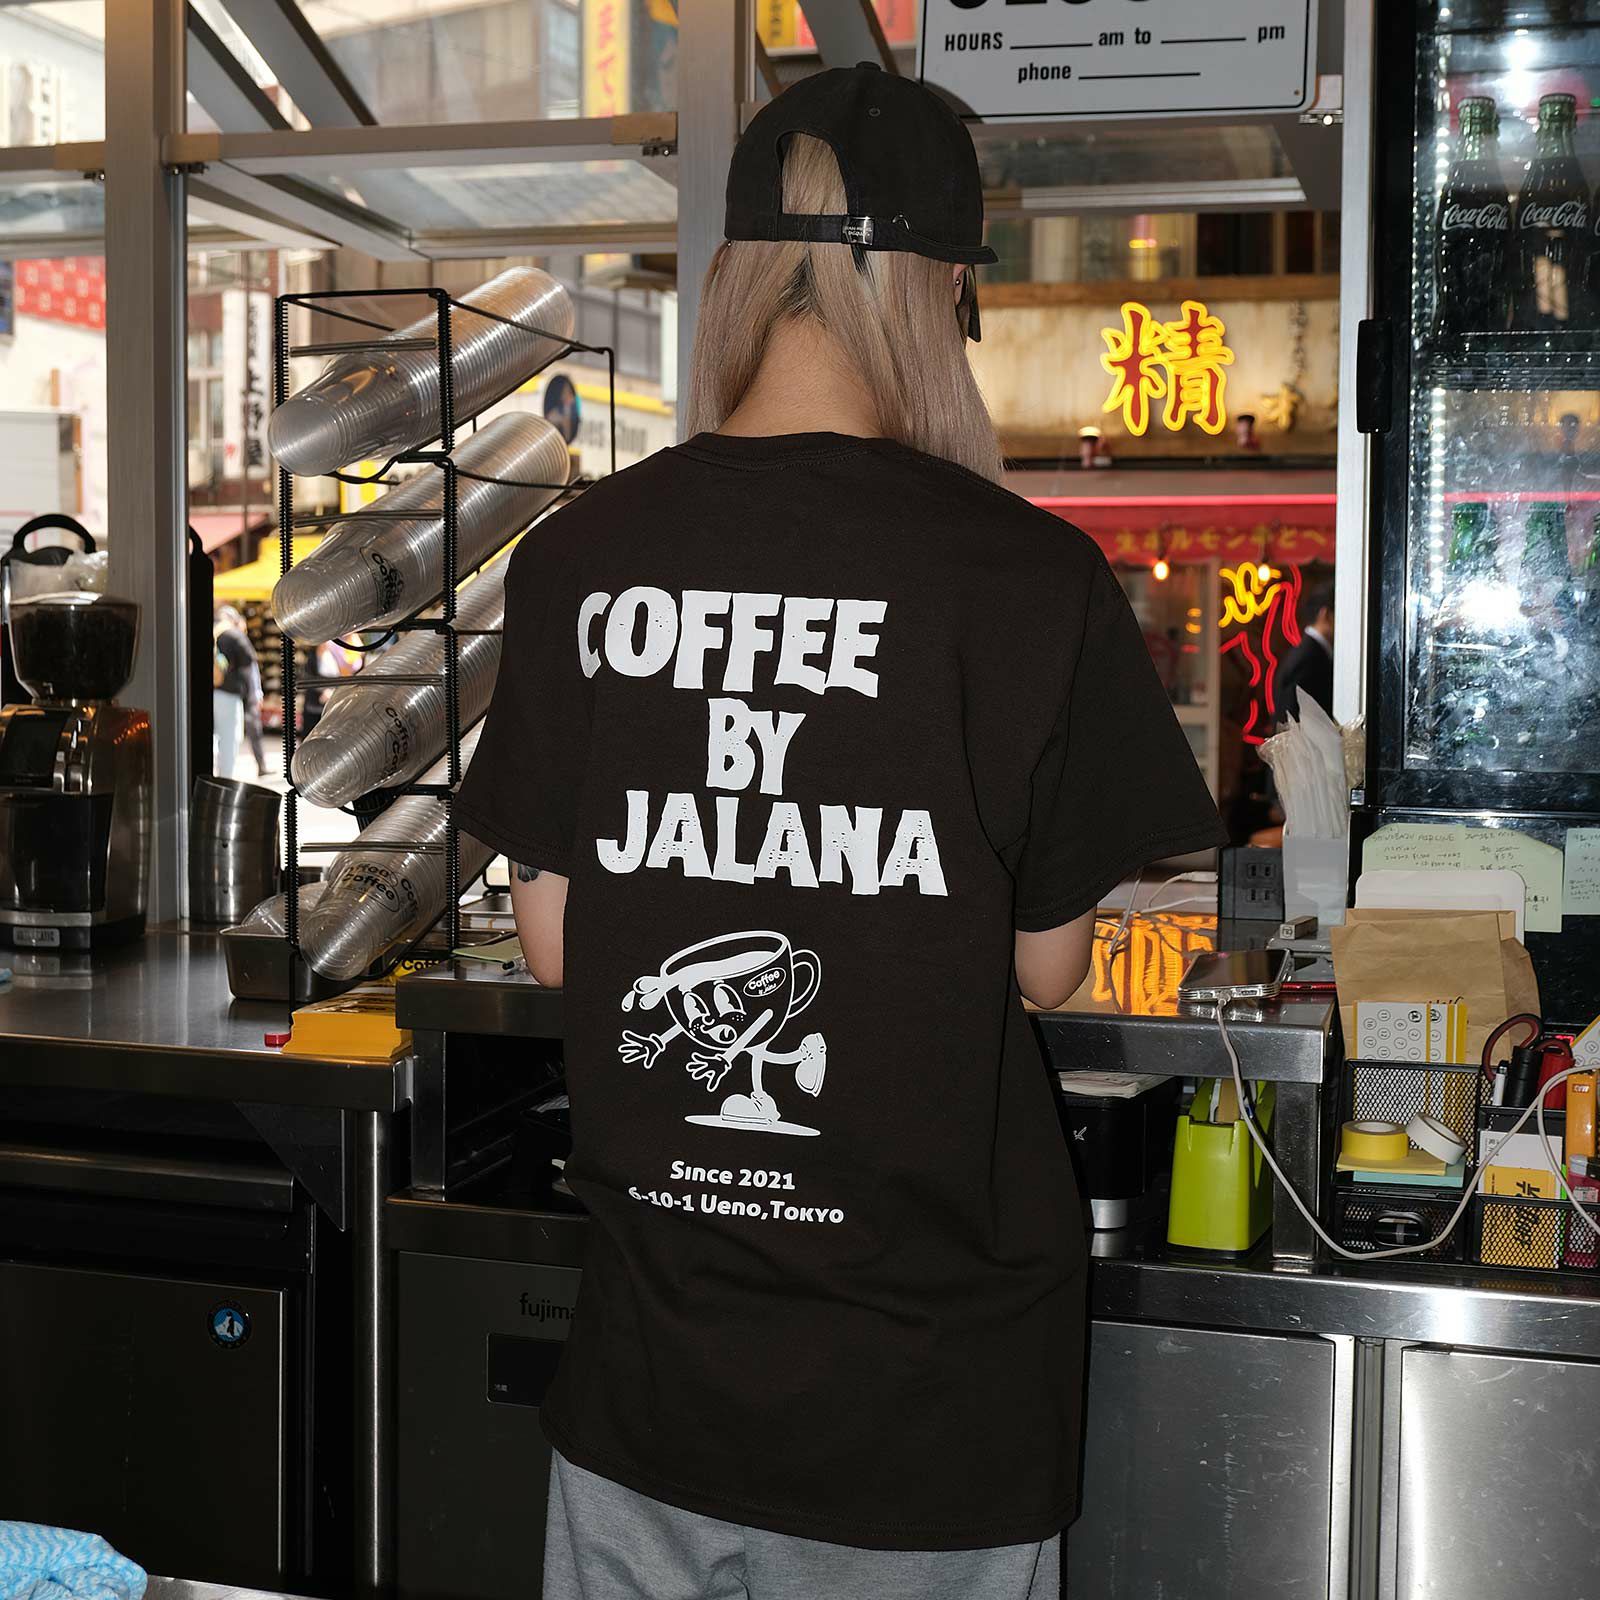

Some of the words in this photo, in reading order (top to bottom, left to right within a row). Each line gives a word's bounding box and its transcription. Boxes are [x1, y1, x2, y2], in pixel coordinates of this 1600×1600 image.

[945, 31, 1003, 52] HOURS
[1098, 29, 1125, 47] am
[1134, 27, 1152, 45] to
[1257, 26, 1285, 44] pm
[1017, 62, 1072, 84] phone
[1101, 300, 1235, 437] 精
[578, 586, 888, 698] COFFEE
[706, 697, 807, 796] BY
[596, 790, 949, 897] JALANA
[748, 970, 781, 990] Coffee
[670, 1160, 734, 1185] Since
[738, 1168, 796, 1190] 2021
[628, 1186, 695, 1212] 6-10-1
